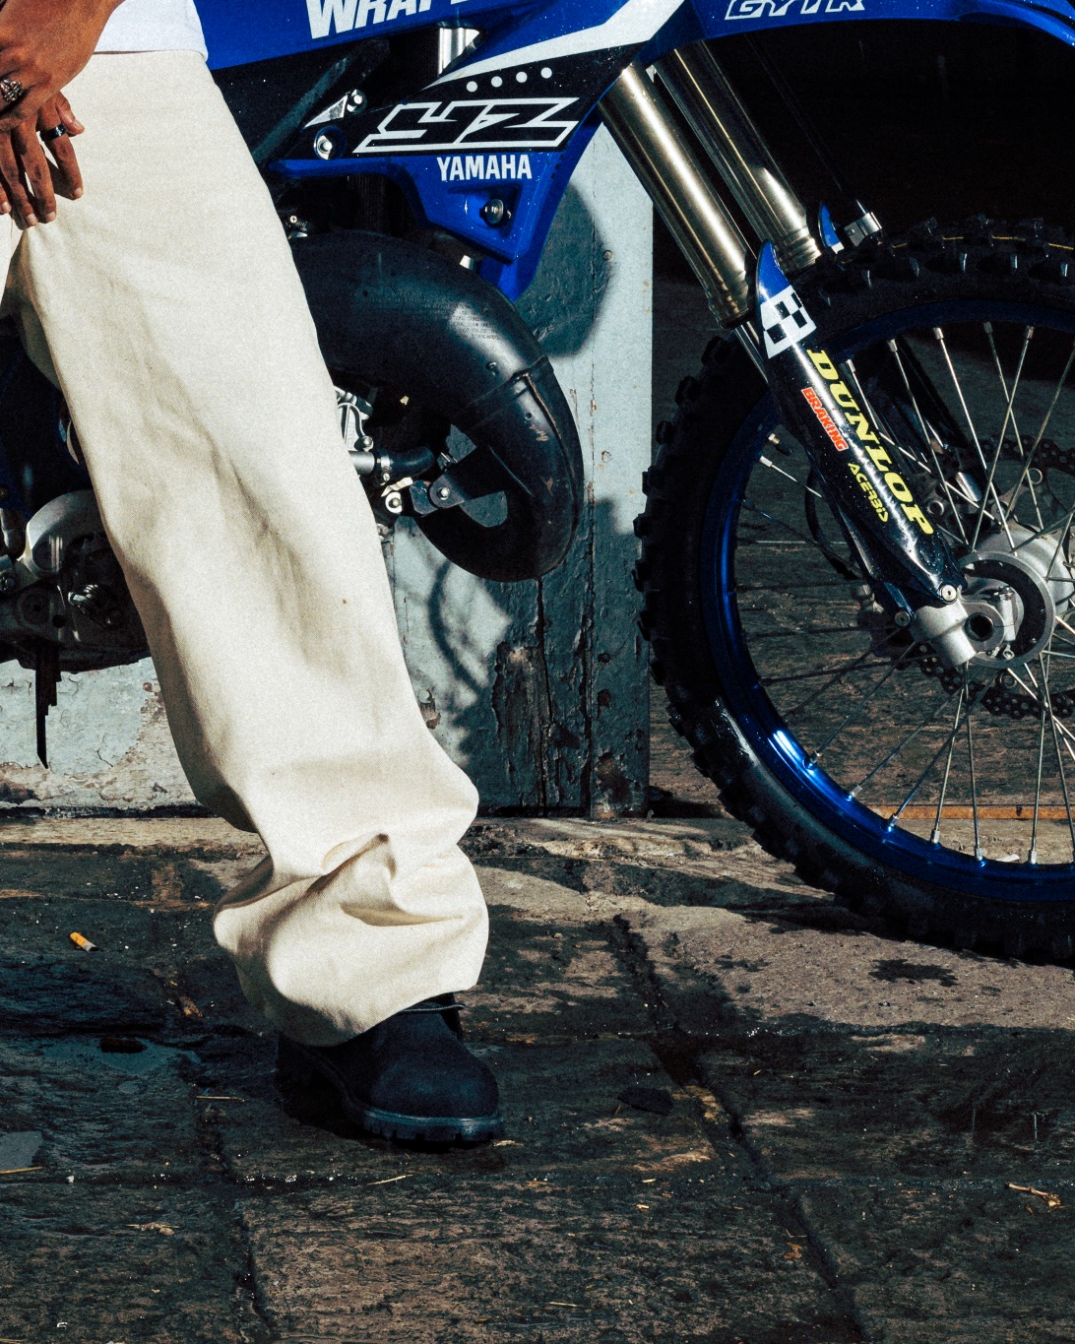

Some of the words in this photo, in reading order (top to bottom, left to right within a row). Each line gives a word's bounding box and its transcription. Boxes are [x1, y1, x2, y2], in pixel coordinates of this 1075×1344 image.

[436, 154, 532, 181] YAMAHA
[801, 387, 848, 452] BRAKING
[807, 349, 934, 535] DUNLOP
